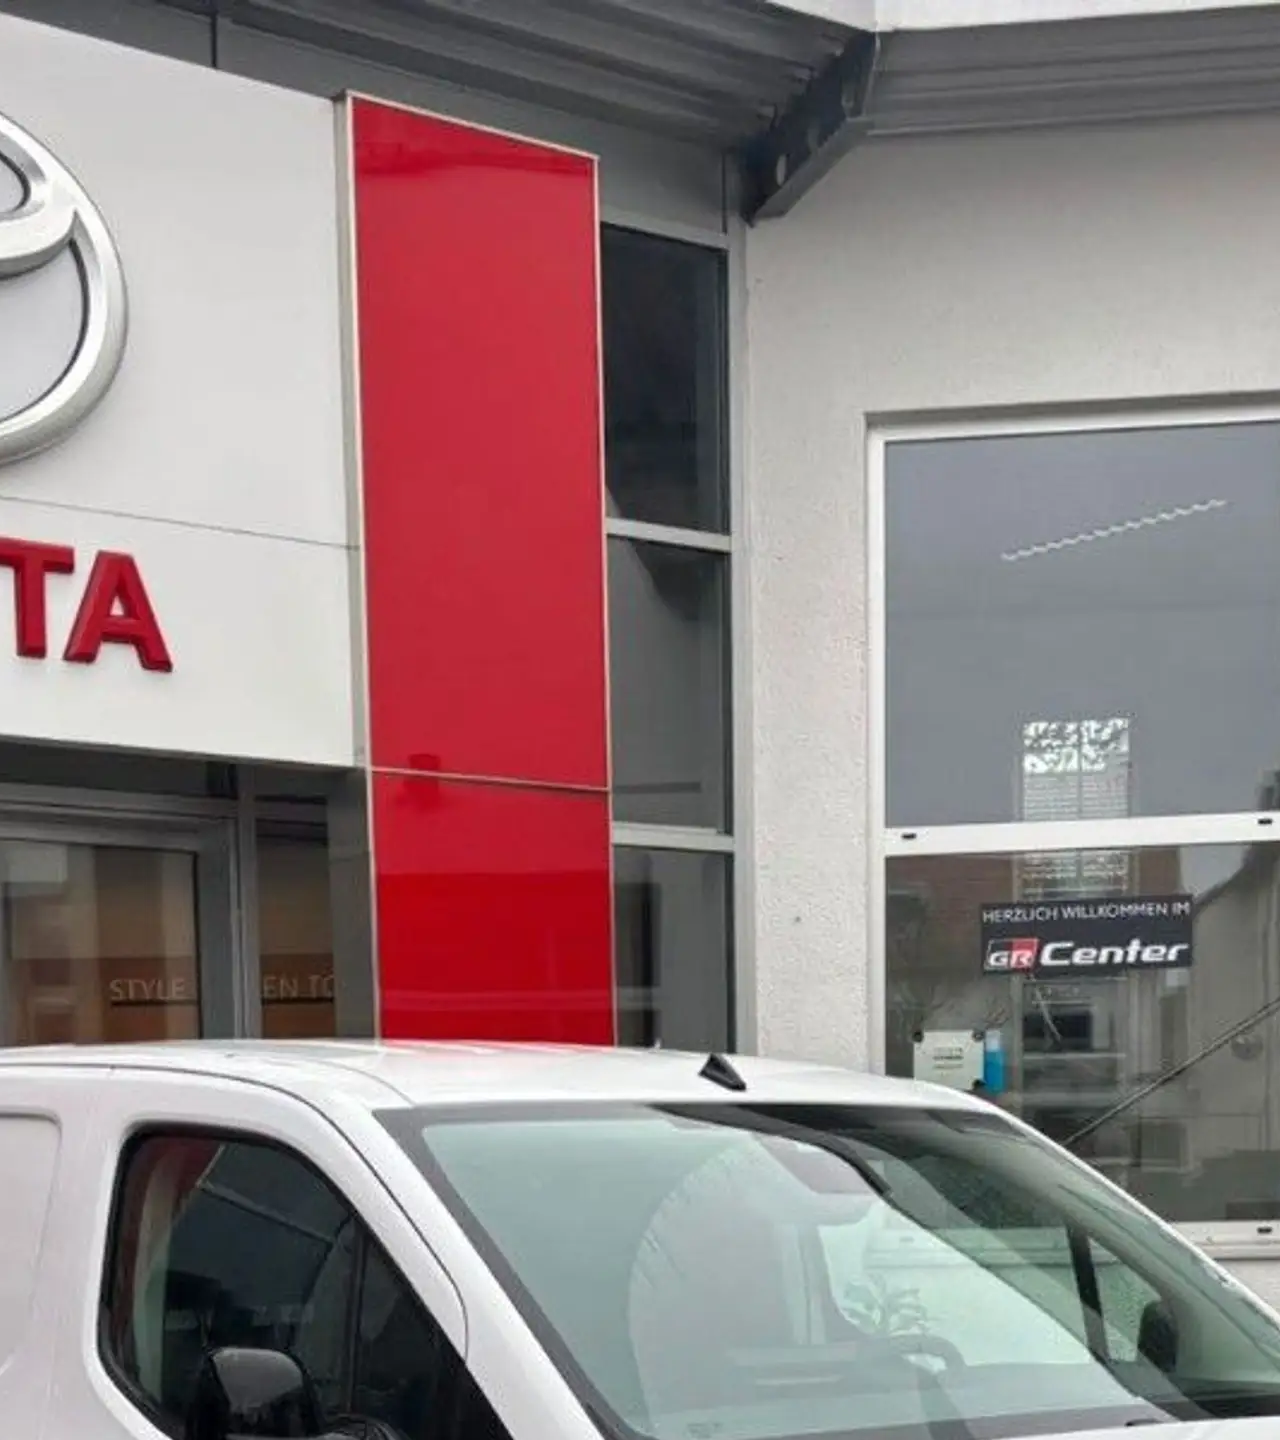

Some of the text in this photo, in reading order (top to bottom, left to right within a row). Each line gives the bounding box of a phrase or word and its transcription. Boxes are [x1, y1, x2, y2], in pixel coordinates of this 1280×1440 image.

[982, 902, 1191, 924] HERZLICH WILLKOMMEN IM
[1039, 938, 1190, 967] Center
[109, 977, 187, 1001] STYLE
